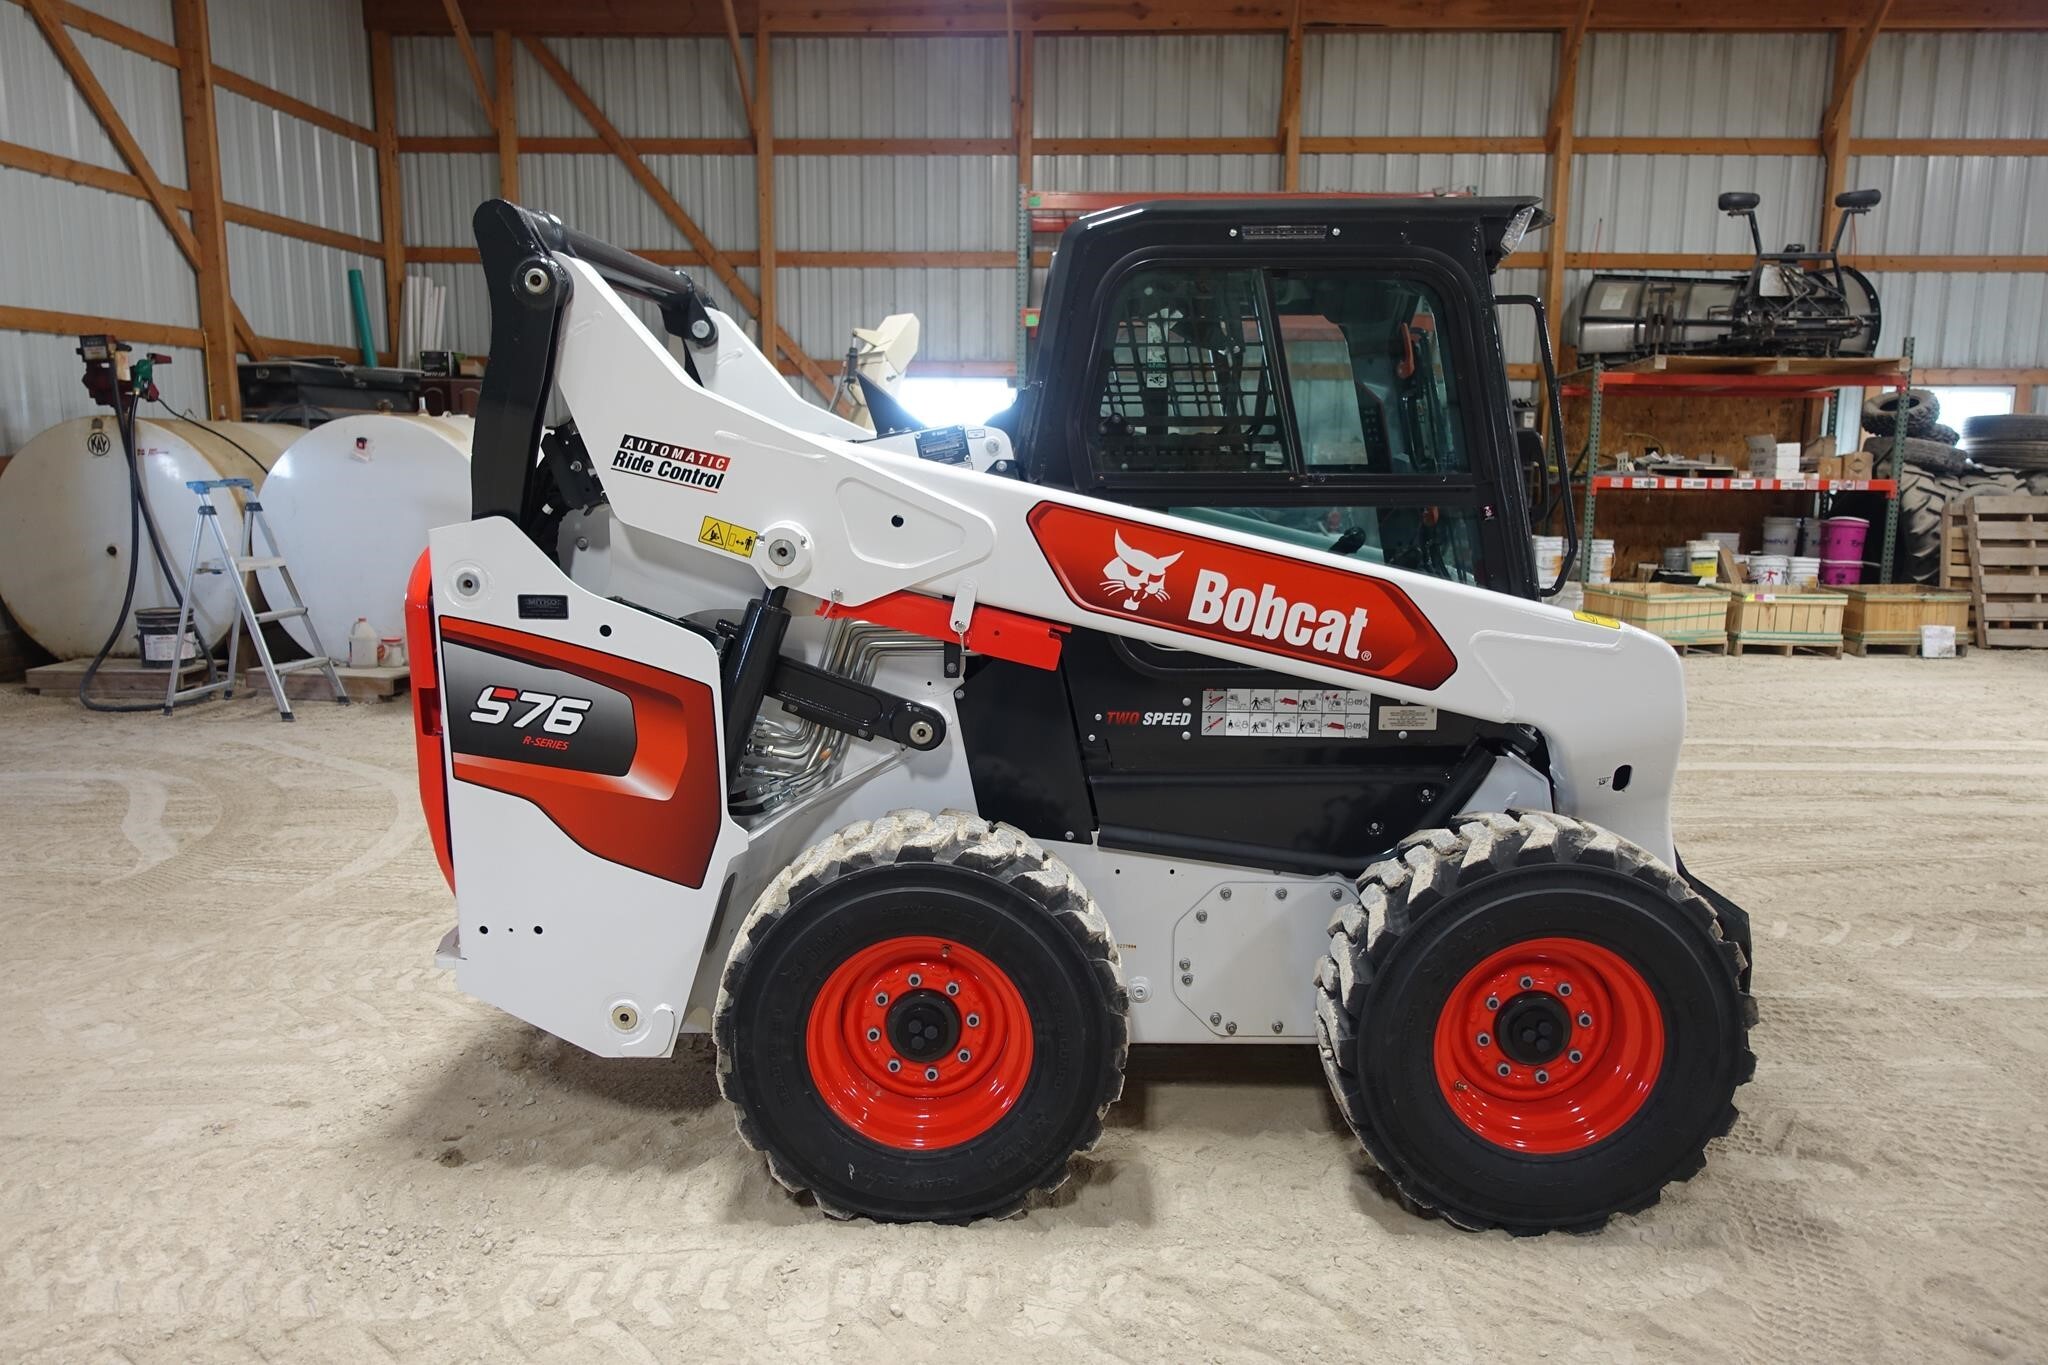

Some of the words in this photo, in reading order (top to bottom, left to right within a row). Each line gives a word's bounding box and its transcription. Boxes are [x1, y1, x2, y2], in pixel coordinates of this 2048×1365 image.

[612, 450, 654, 473] Ride
[657, 461, 725, 489] Control
[624, 437, 726, 470] AUTOMATIC
[1187, 568, 1368, 660] Bobcat
[469, 685, 593, 735] S76
[1106, 711, 1141, 726] TWO
[1142, 711, 1192, 726] SPEED
[522, 735, 570, 751] R-SERIES
